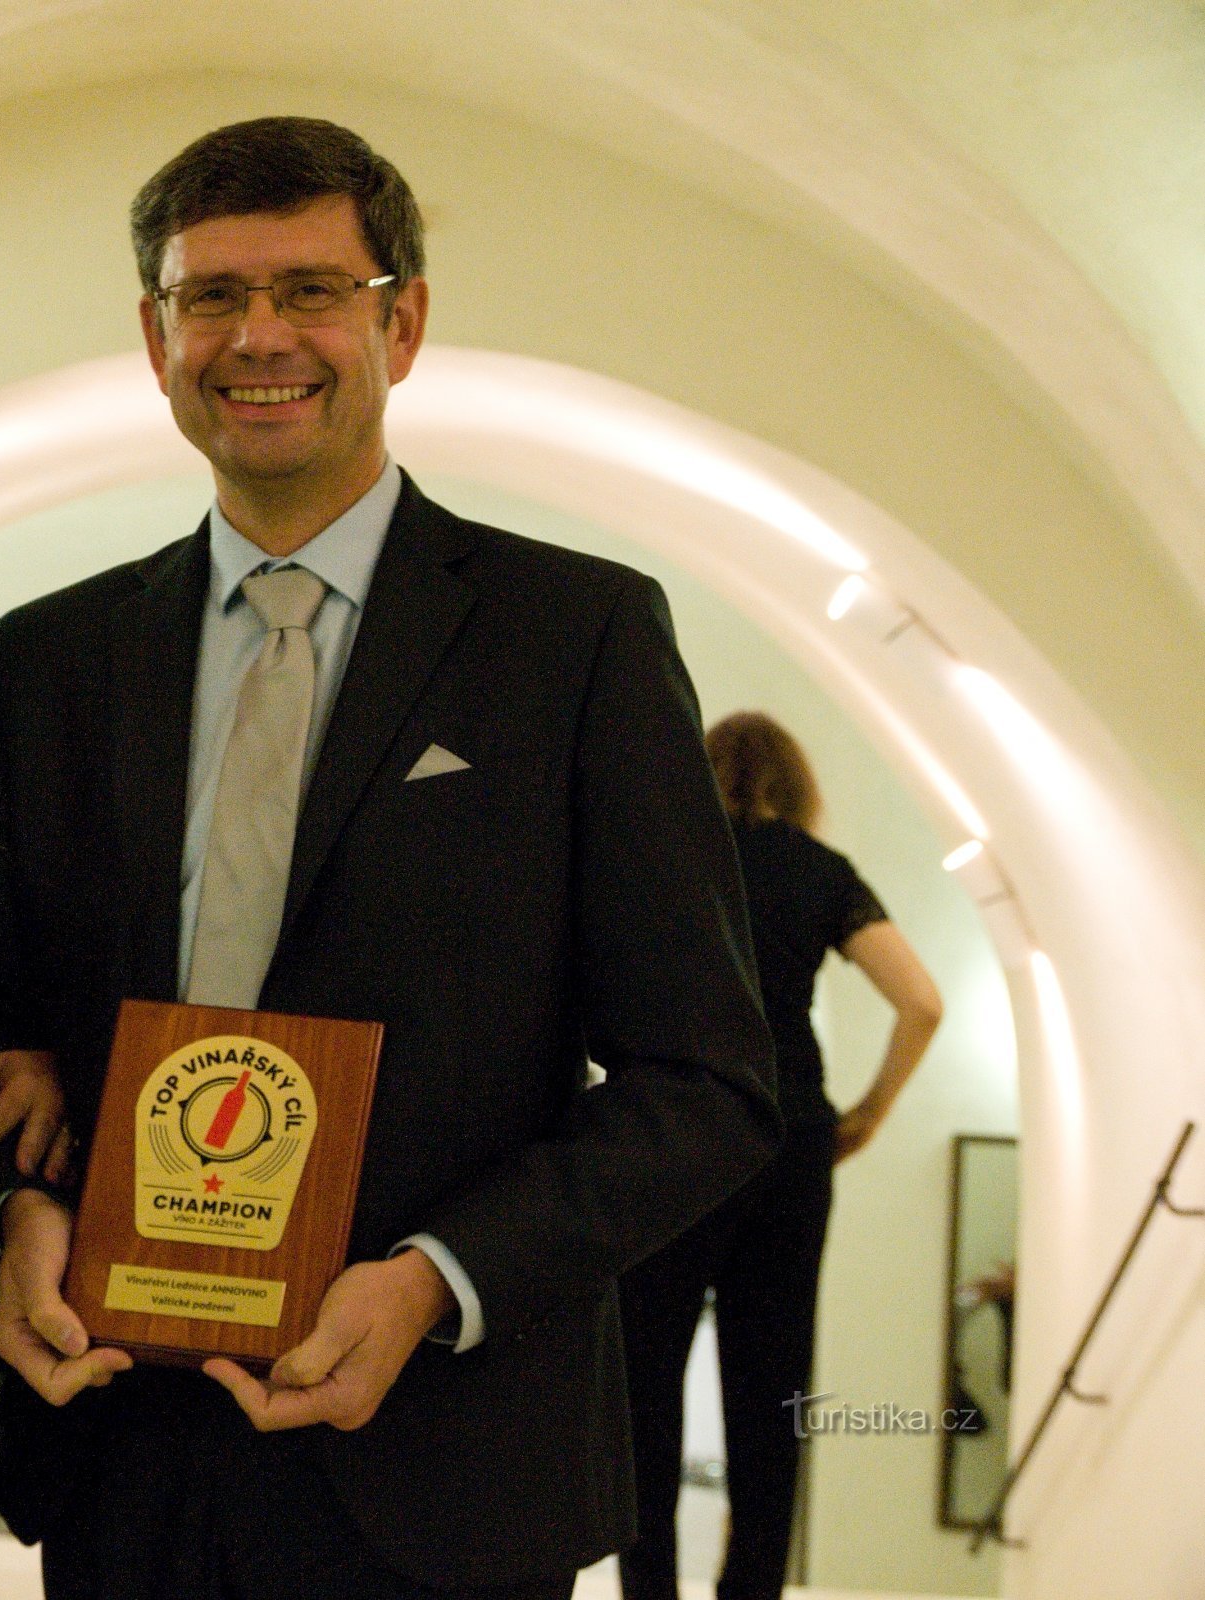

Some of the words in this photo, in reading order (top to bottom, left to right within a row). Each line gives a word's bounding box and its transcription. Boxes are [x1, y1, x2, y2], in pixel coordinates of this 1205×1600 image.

[150, 1075, 179, 1117] TOP
[181, 1046, 296, 1090] VINAŘSKÝ
[284, 1098, 307, 1131] CÍL
[153, 1195, 272, 1220] CHAMPION
[207, 1217, 246, 1229] ZÁŽITEK
[126, 1274, 170, 1288] Vinařství
[171, 1278, 208, 1292] Lednice
[210, 1284, 268, 1298] ANNOVINO
[151, 1295, 190, 1308] Valtické
[192, 1299, 235, 1313] podzemí
